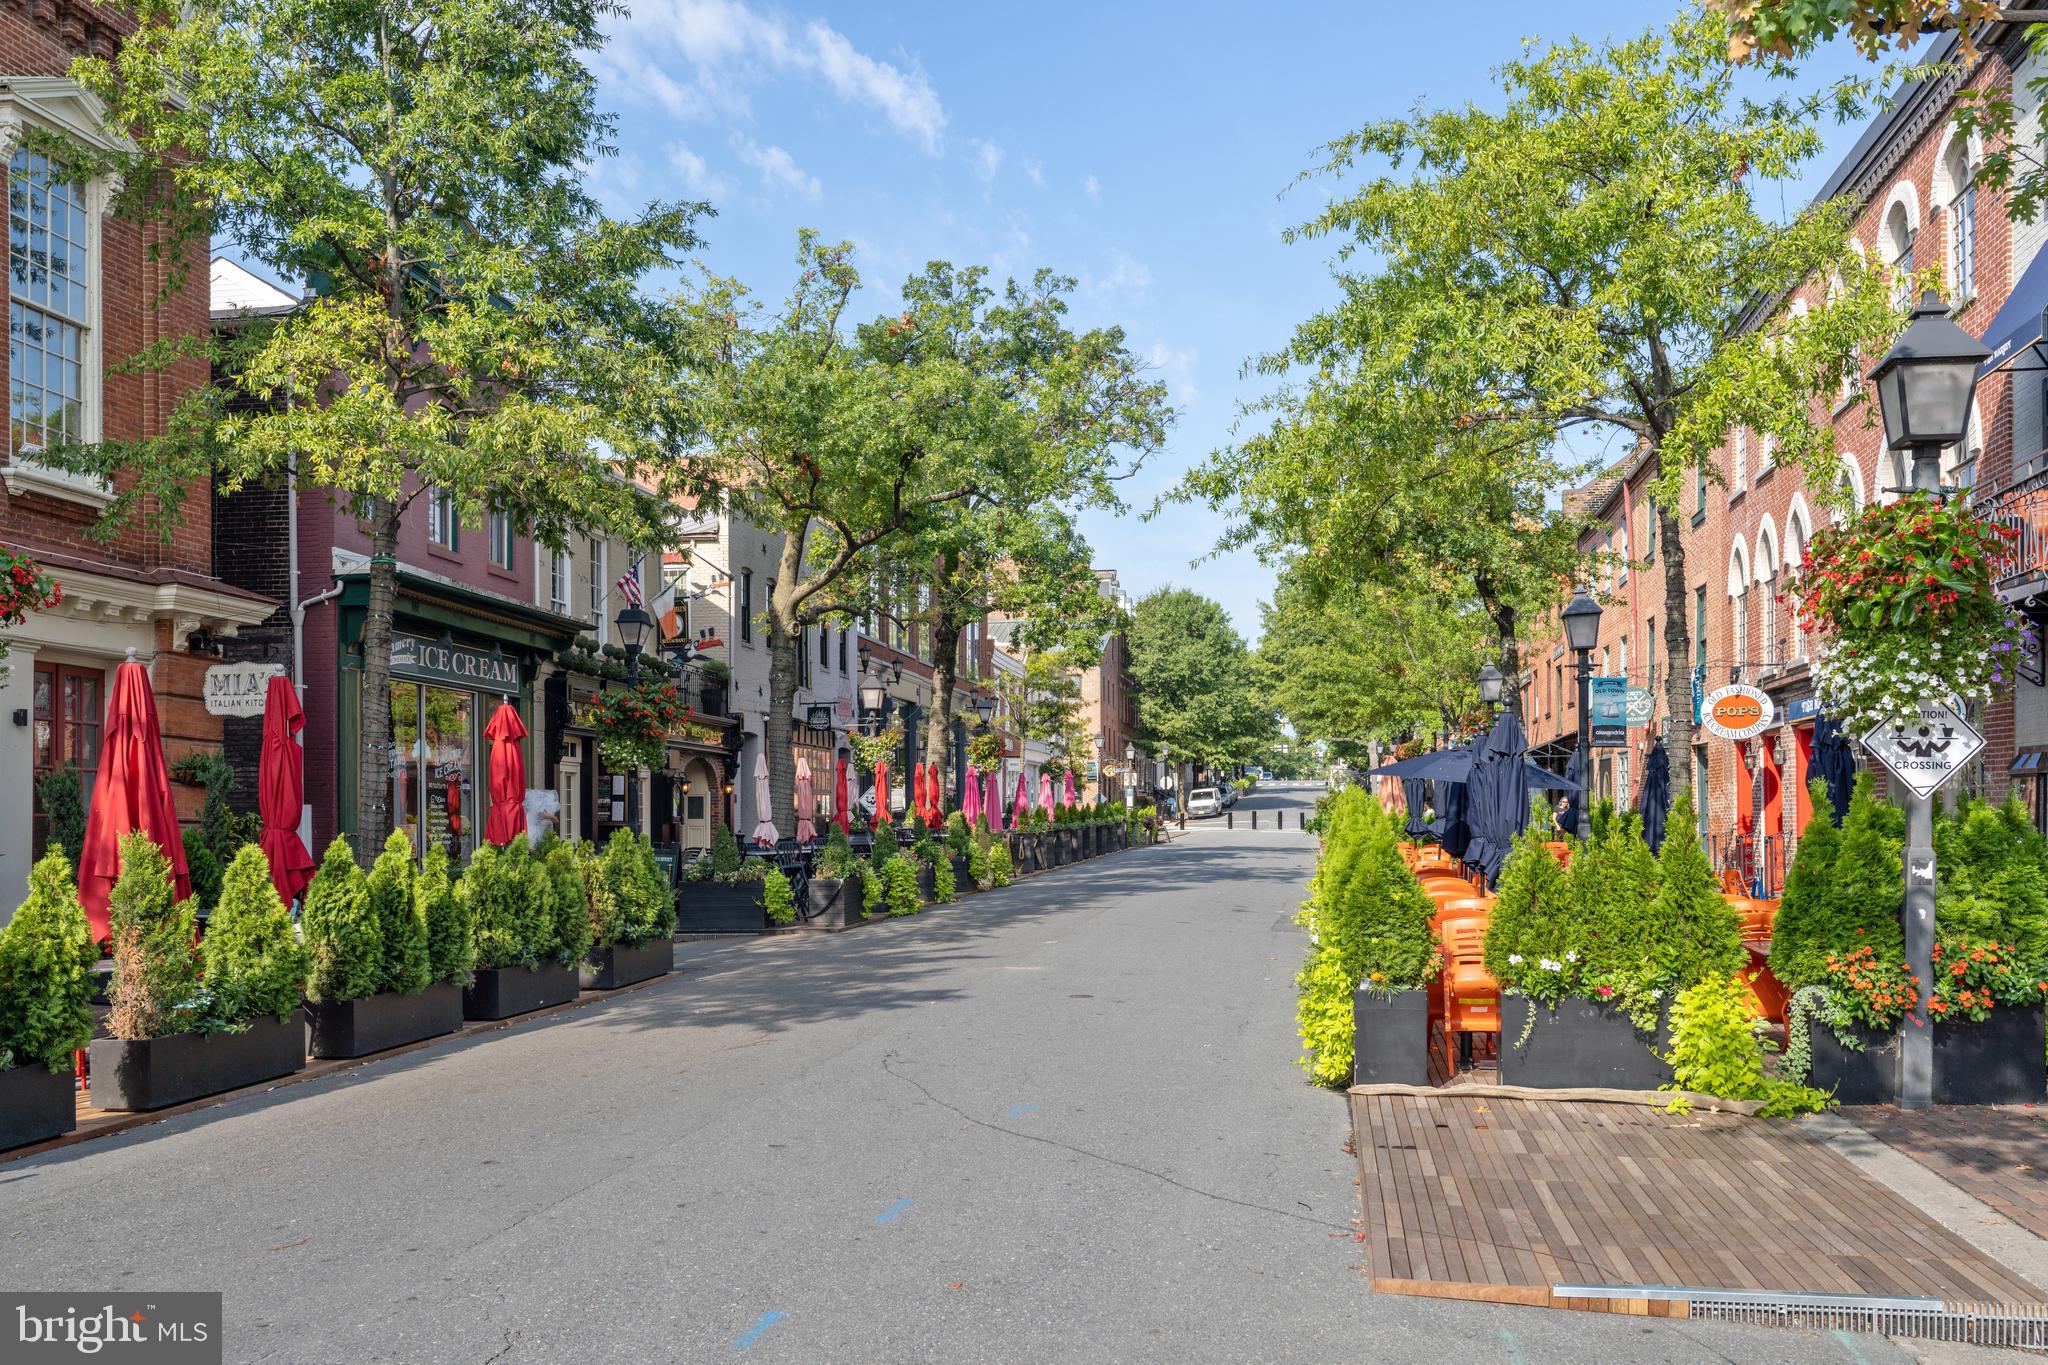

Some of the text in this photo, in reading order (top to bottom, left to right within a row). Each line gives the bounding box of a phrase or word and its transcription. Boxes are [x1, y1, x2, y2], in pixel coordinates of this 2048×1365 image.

[418, 644, 517, 684] ICE CREAM
[210, 671, 275, 696] MIA'
[210, 699, 264, 708] ITALIAN KITC
[1708, 686, 1768, 706] OLD FASHIONED
[1715, 705, 1760, 717] POP'S
[1918, 710, 1948, 719] TION!
[1710, 723, 1737, 738] CREAM
[1738, 712, 1772, 738] COMPANY
[1894, 761, 1951, 770] CROSSING
